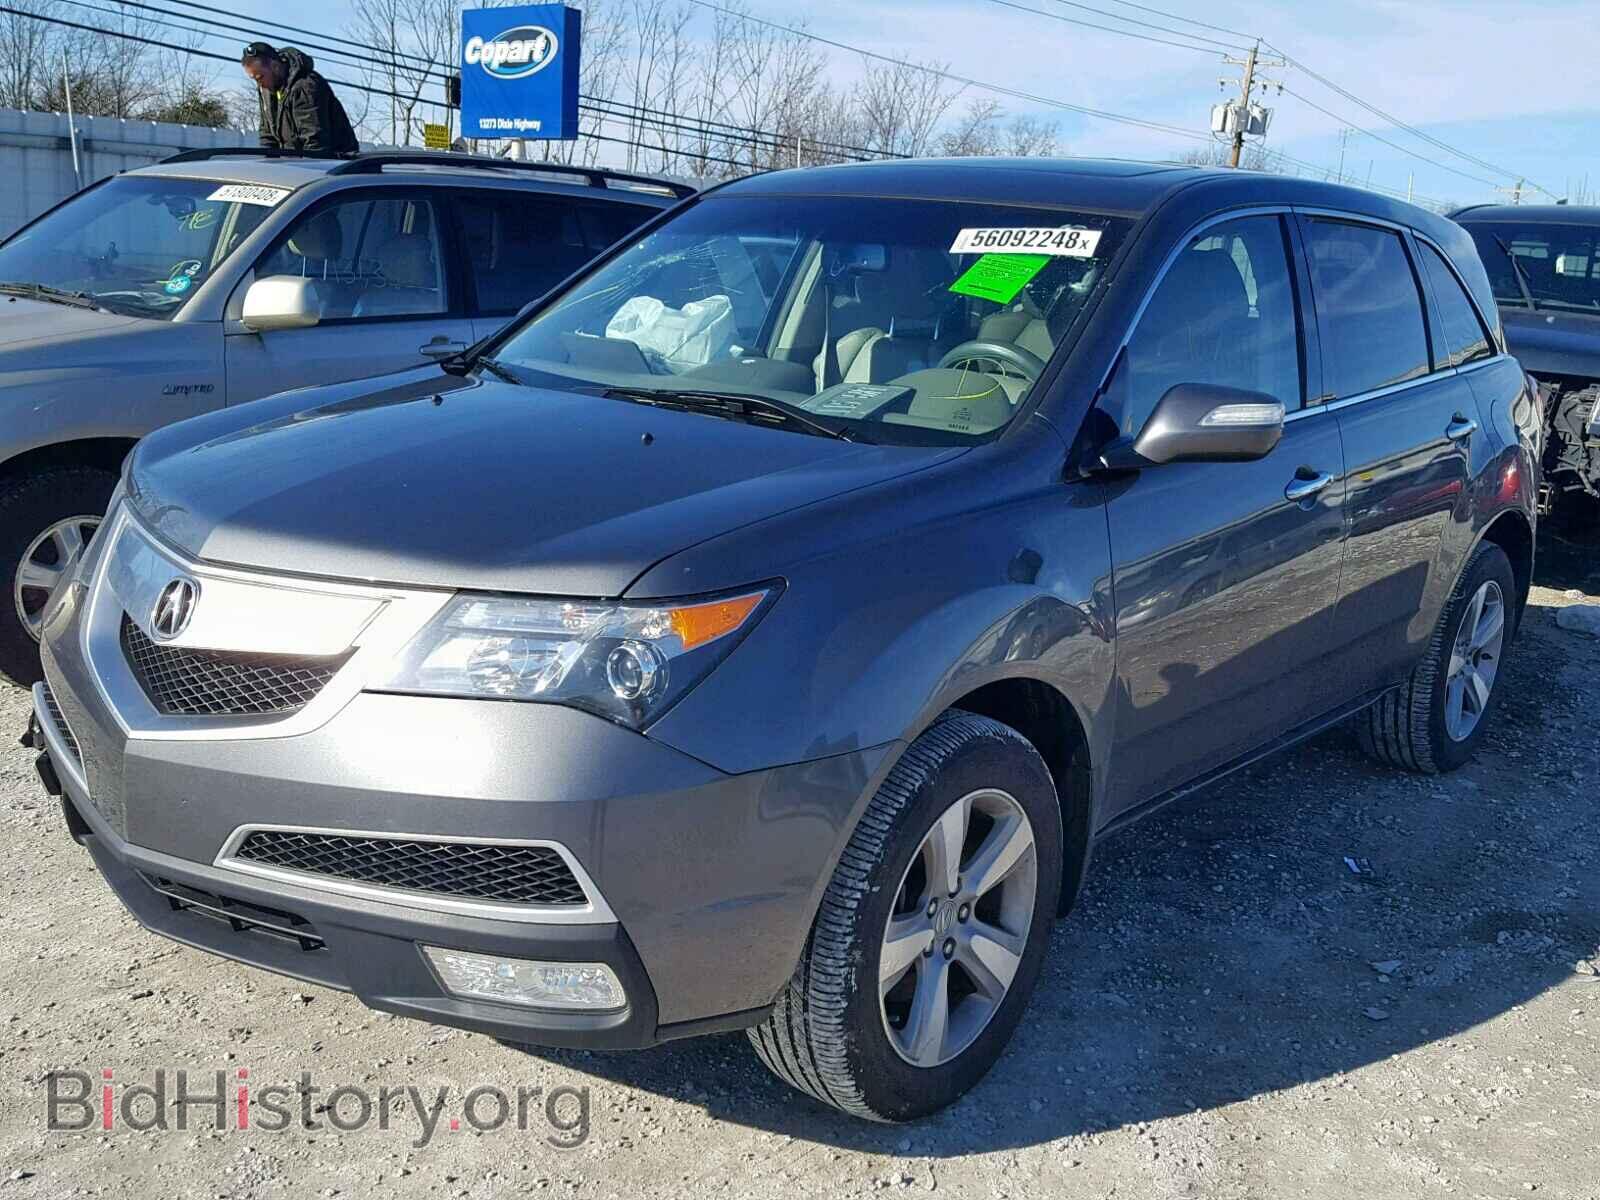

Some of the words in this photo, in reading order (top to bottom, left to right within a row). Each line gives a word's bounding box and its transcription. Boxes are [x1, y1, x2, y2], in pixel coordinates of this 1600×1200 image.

[465, 31, 547, 70] Copart
[497, 118, 513, 129] Dixie
[513, 118, 541, 132] Highway
